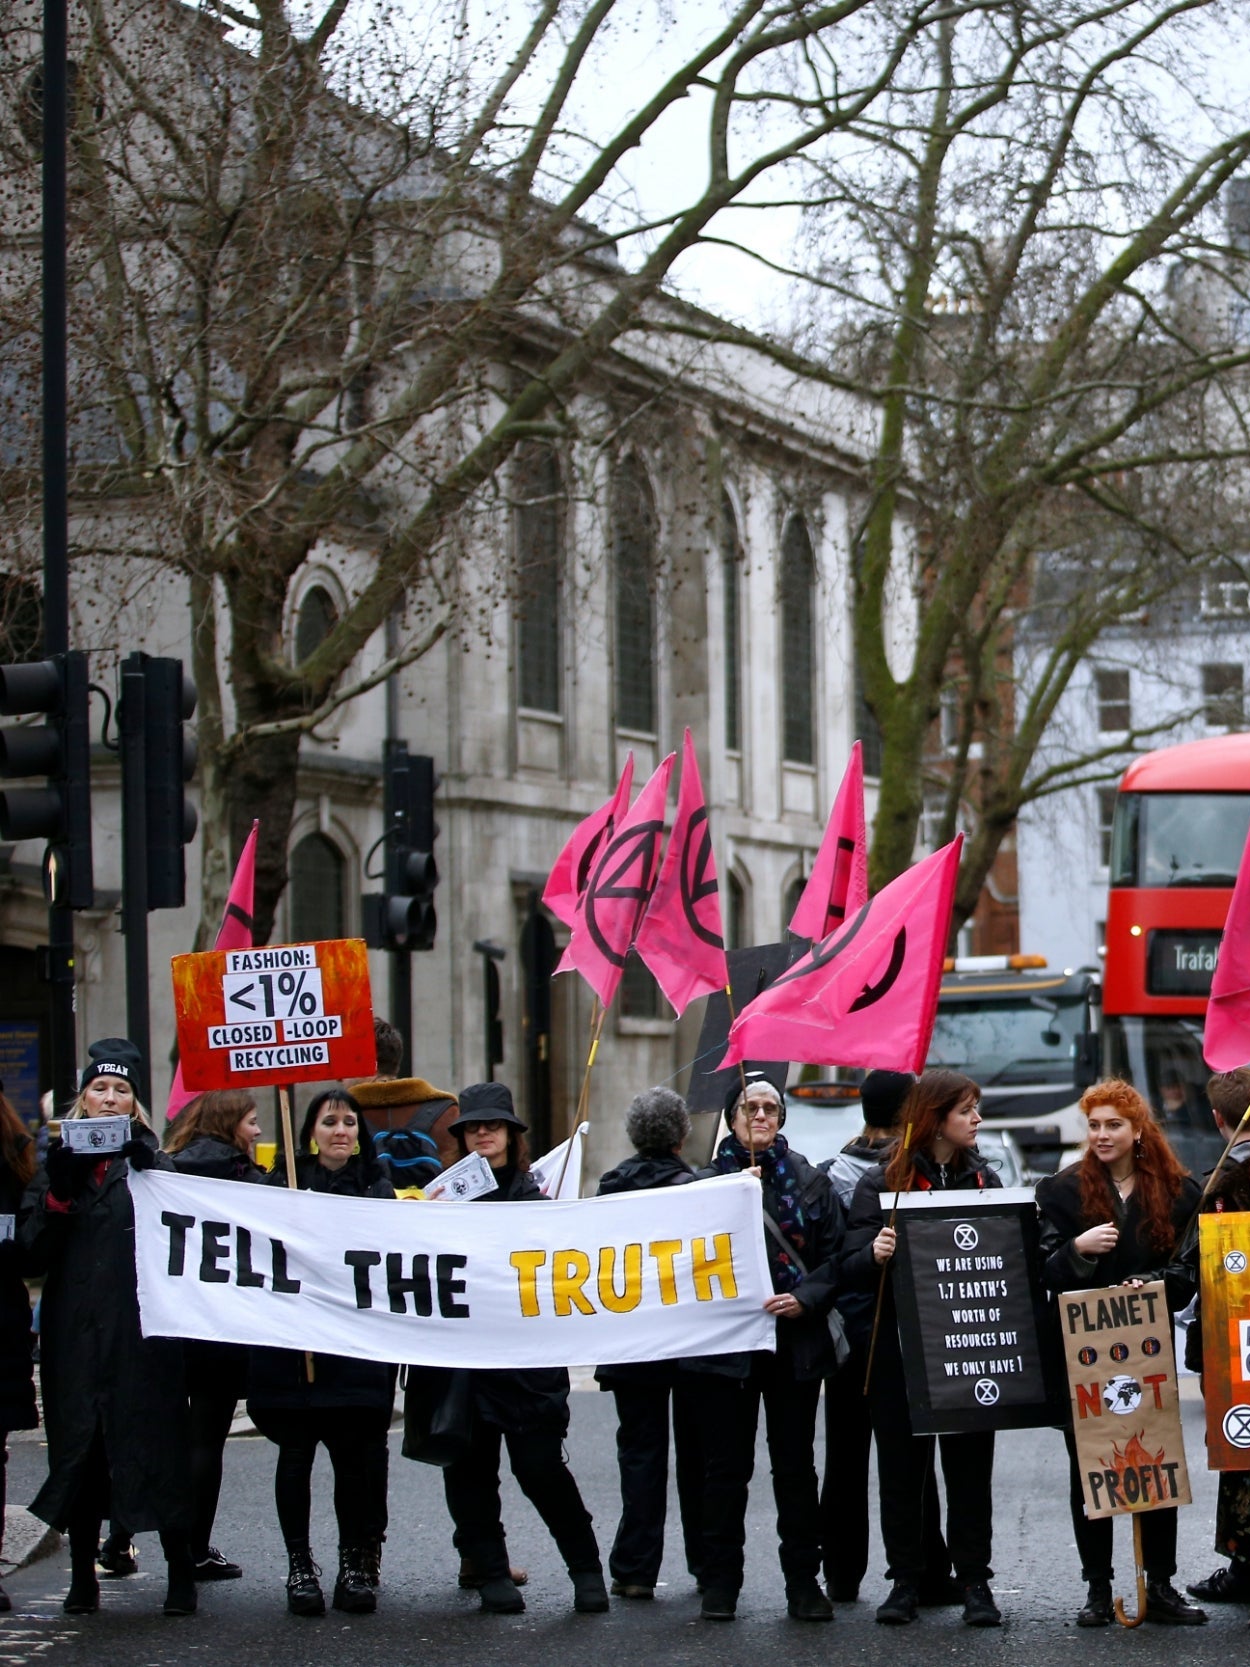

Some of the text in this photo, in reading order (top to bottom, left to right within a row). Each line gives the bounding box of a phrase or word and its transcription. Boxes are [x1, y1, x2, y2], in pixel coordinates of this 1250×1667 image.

[232, 949, 310, 971] FASHION:
[1174, 945, 1218, 971] Trafal
[229, 971, 317, 1018] <1%
[212, 1019, 338, 1046] CLOSED -LOOP
[235, 1046, 324, 1069] RECYCLING
[97, 1063, 128, 1076] VEGAN
[161, 1210, 738, 1318] TELL THE TRUTH
[936, 1256, 1003, 1272] WE ARE USING
[938, 1280, 1008, 1299] 1.7 EARTH'S
[952, 1308, 1001, 1323] WORTH OF
[1066, 1292, 1159, 1334] PLANET
[945, 1331, 1017, 1349] RESOURCES BUT
[944, 1355, 1023, 1376] WE ONLY HAVE 1
[1087, 1462, 1180, 1510] PROFIT
